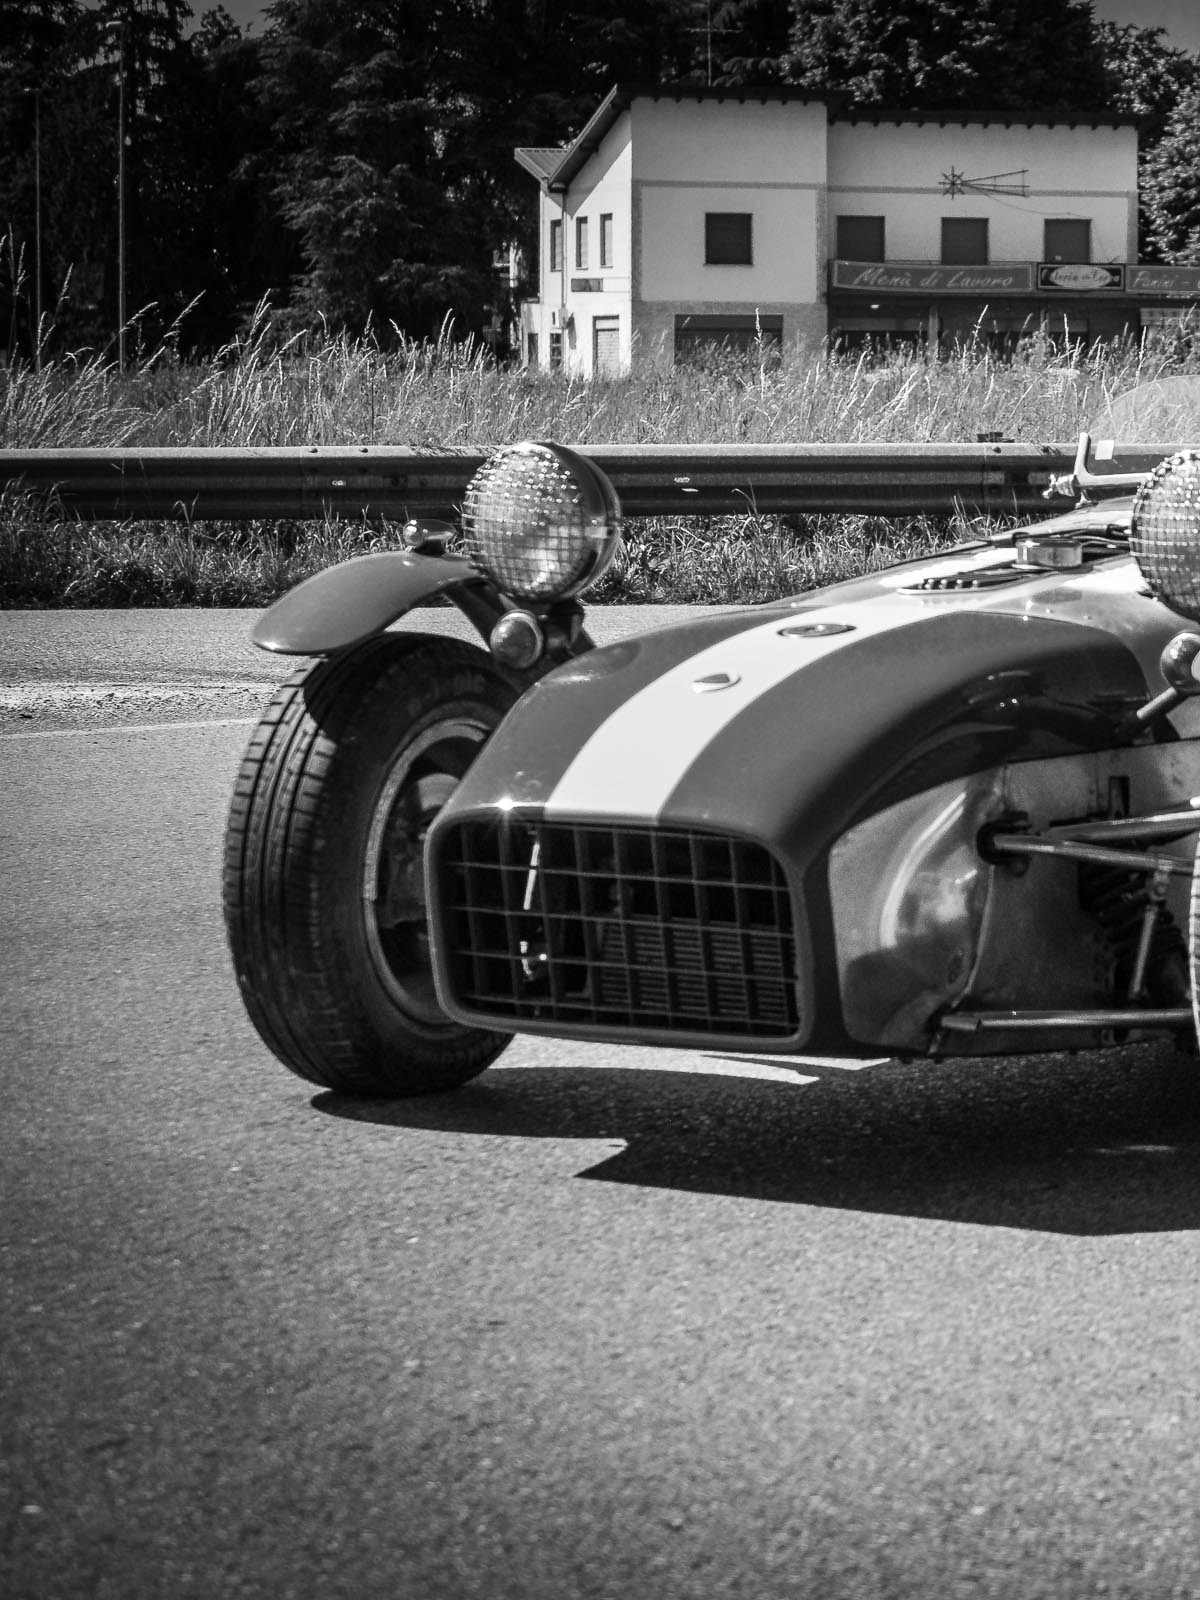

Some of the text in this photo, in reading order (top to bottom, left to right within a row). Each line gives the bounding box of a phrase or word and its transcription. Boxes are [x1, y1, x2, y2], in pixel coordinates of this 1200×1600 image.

[919, 270, 943, 287] di
[946, 271, 1014, 288] Lavoro
[1132, 270, 1179, 288] Panini
